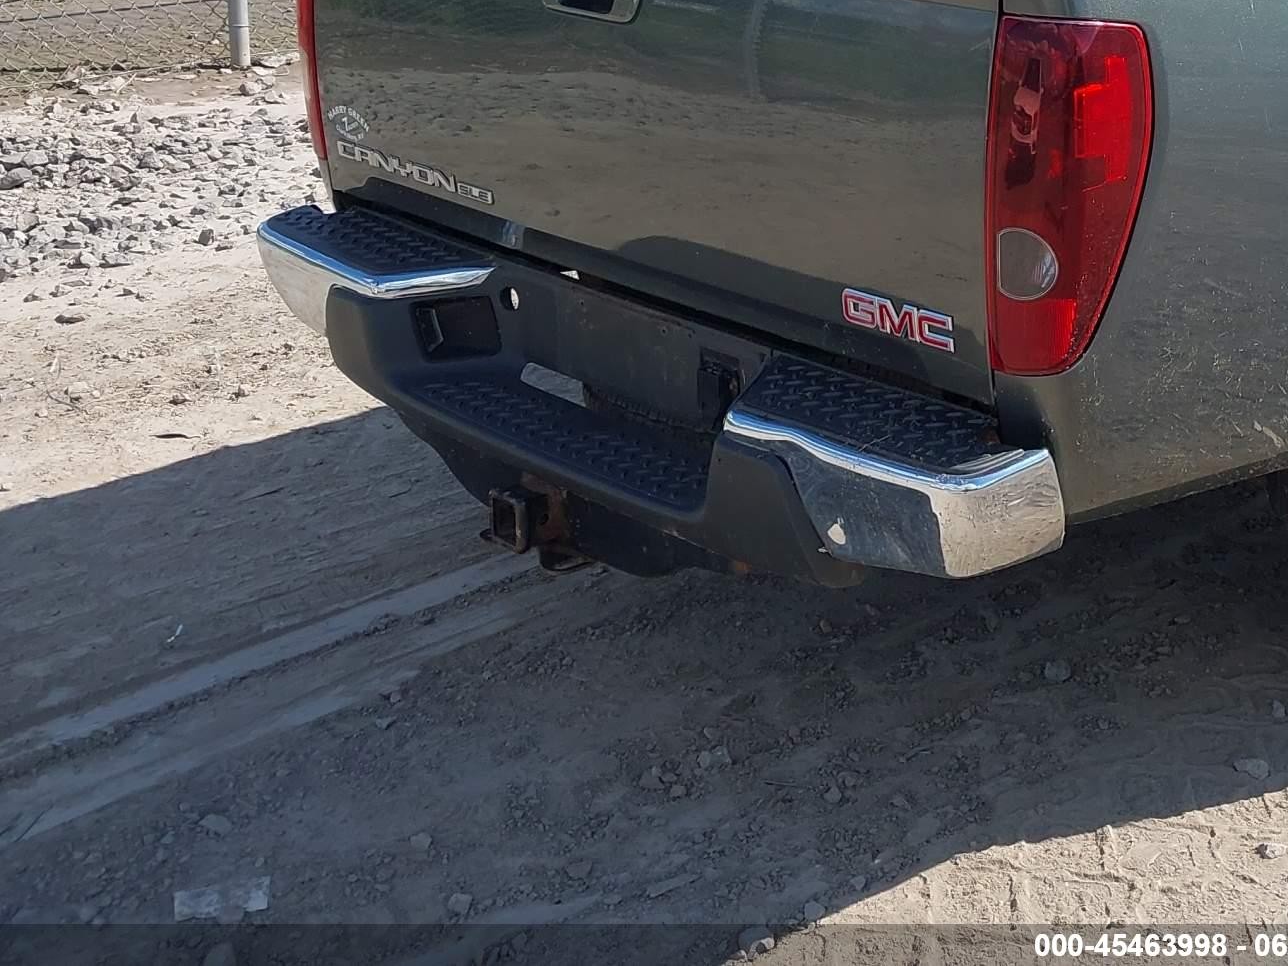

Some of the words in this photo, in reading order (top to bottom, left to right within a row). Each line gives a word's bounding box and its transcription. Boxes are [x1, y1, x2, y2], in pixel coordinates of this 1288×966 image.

[336, 140, 456, 193] CANYON
[457, 182, 494, 205] SLE
[841, 287, 955, 354] GMC
